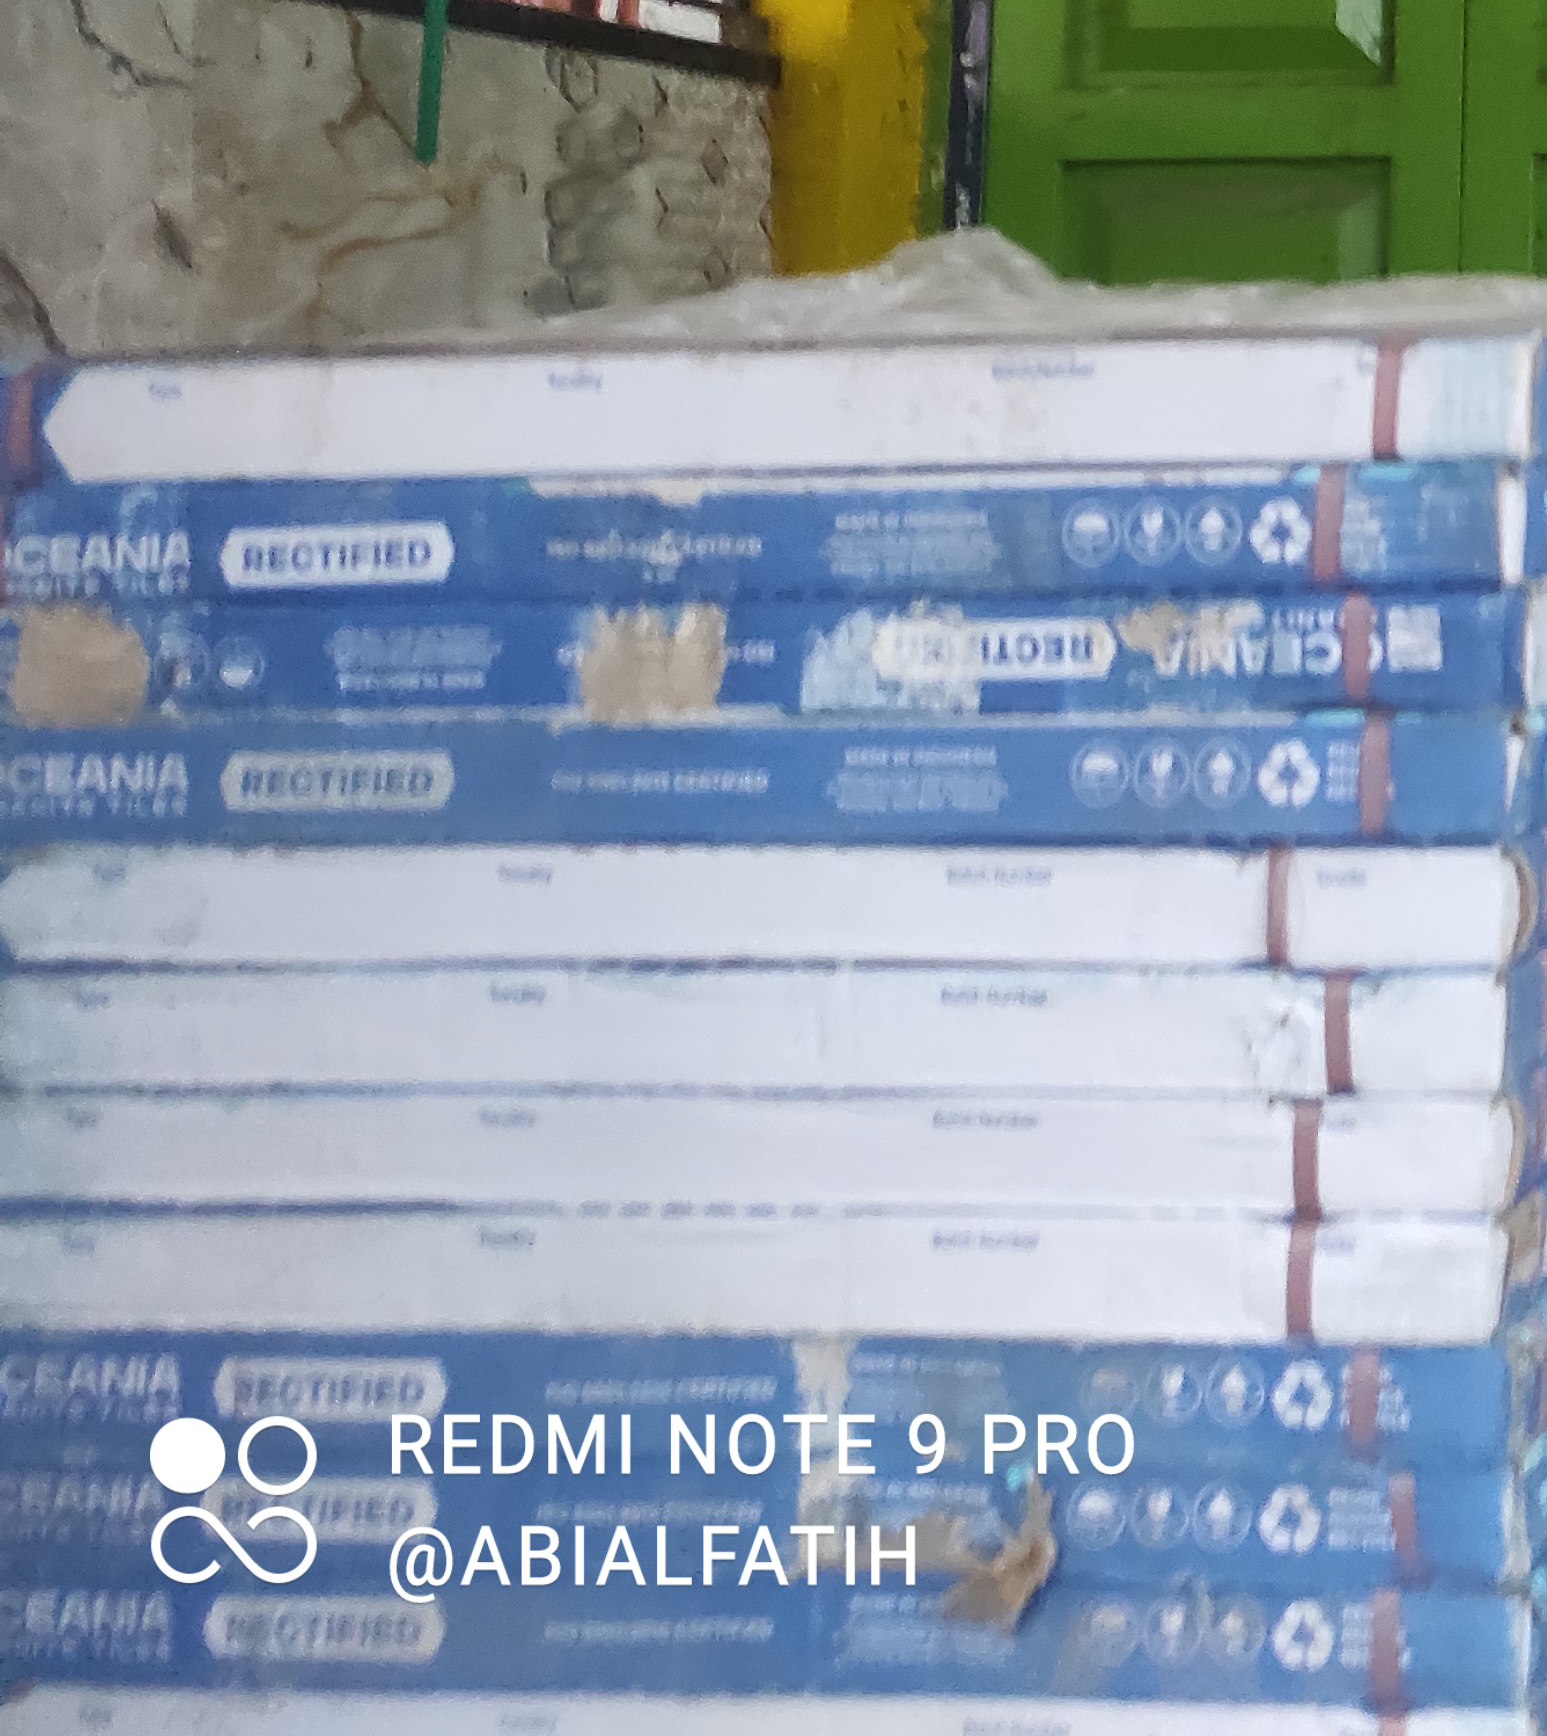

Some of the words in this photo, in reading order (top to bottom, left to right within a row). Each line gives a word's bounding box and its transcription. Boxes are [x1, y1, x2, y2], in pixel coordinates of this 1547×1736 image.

[242, 537, 432, 572] RECTIFIED
[0, 752, 189, 793] CEANIA
[240, 766, 434, 798] RECTIFIED
